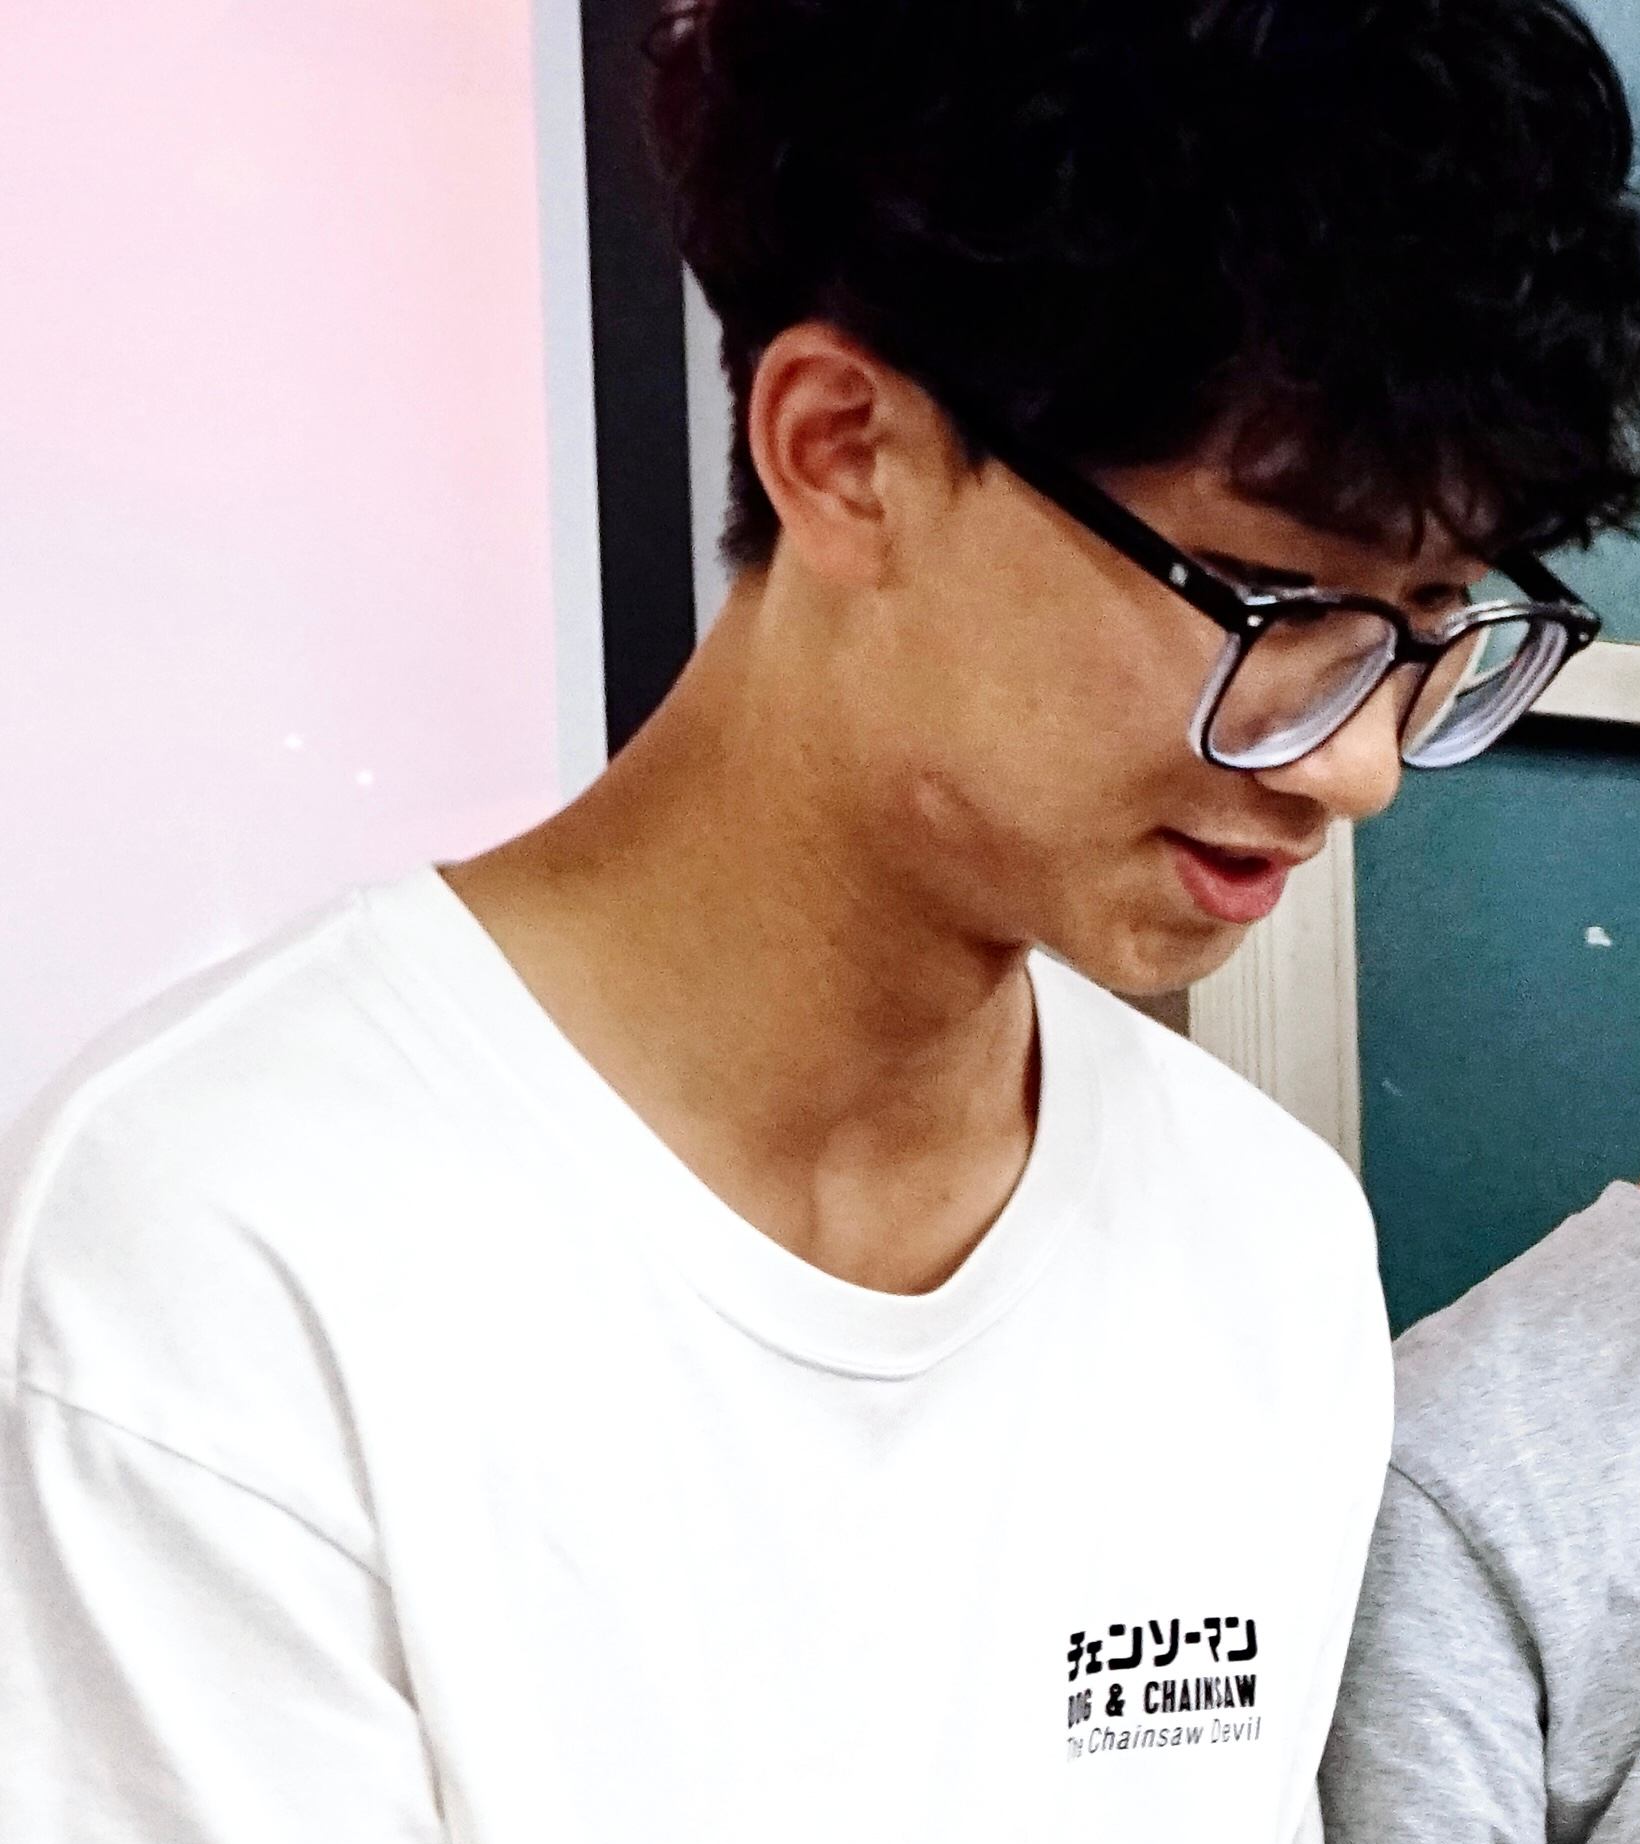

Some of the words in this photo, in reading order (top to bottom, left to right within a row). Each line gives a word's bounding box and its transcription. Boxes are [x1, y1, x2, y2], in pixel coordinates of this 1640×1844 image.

[1067, 1616, 1258, 1682] チェンソーマン
[1105, 1683, 1125, 1717] &
[1144, 1674, 1257, 1715] CHAINSAW
[1087, 1724, 1204, 1754] Chainsaw
[1211, 1716, 1262, 1744] Devil
